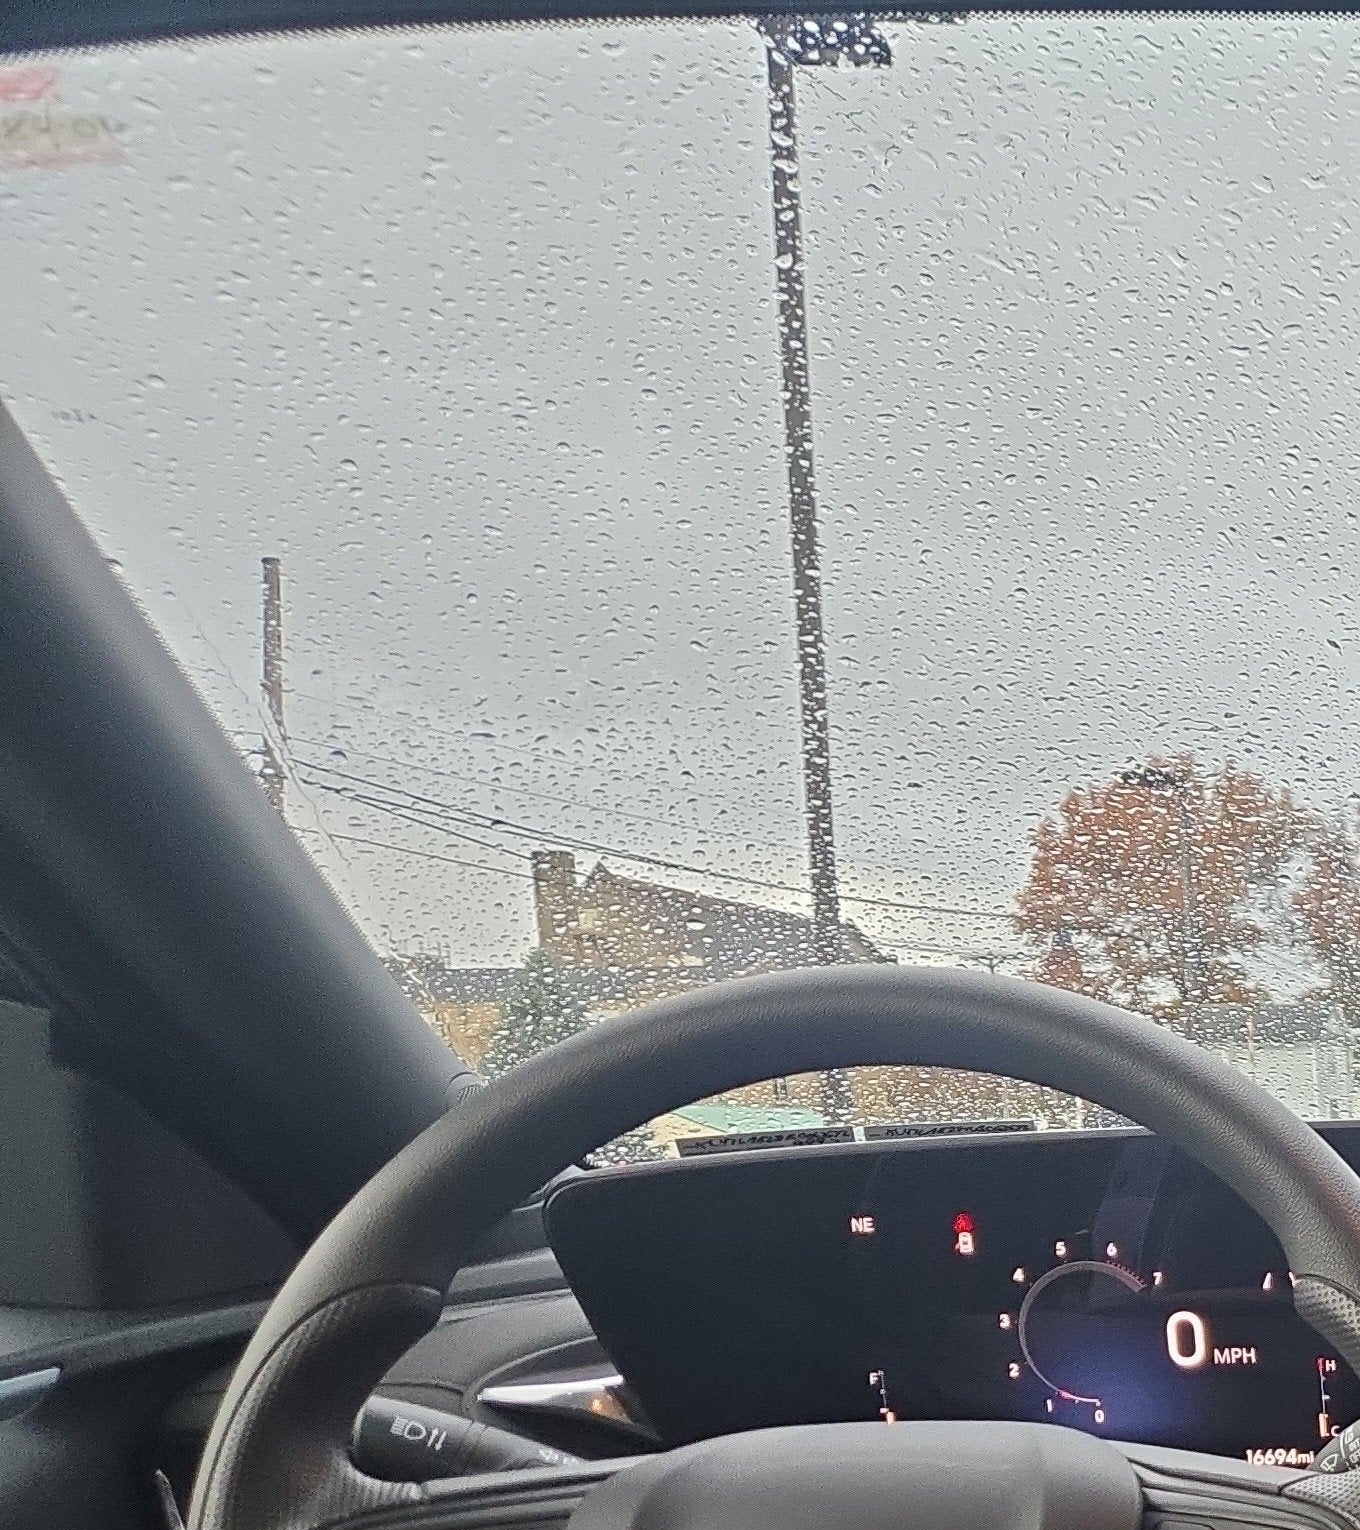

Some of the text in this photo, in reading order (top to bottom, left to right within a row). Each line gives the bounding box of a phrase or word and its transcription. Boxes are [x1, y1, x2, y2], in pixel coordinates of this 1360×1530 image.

[850, 1216, 875, 1233] NE
[1055, 1241, 1067, 1256] 5
[1106, 1242, 1118, 1257] 6
[1012, 1267, 1025, 1283] 4
[1152, 1271, 1163, 1286] 7
[999, 1313, 1011, 1329] 3
[1166, 1310, 1257, 1367] 0 MPH
[1008, 1362, 1020, 1379] 2
[1094, 1409, 1105, 1424] 0
